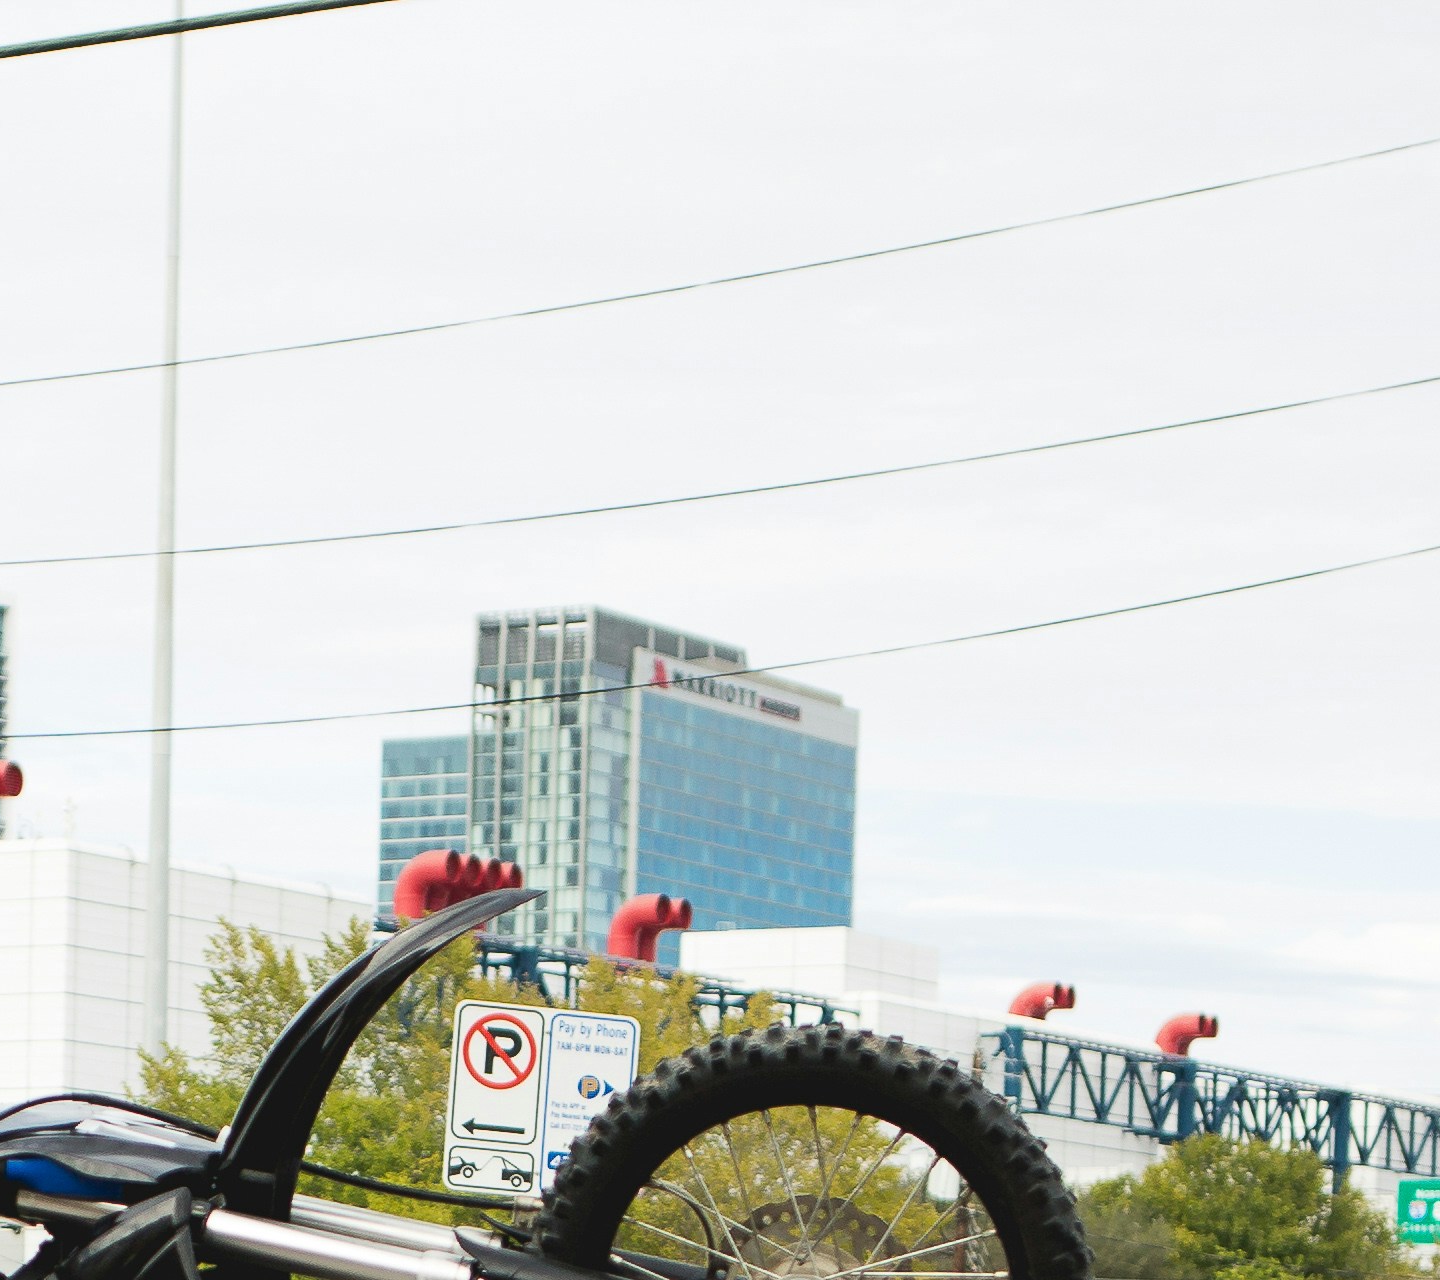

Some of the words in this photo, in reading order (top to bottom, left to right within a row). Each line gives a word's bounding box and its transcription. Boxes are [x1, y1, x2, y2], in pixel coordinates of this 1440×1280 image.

[559, 1020, 576, 1037] Pay
[580, 1021, 592, 1038] by
[596, 1023, 628, 1039] Phone
